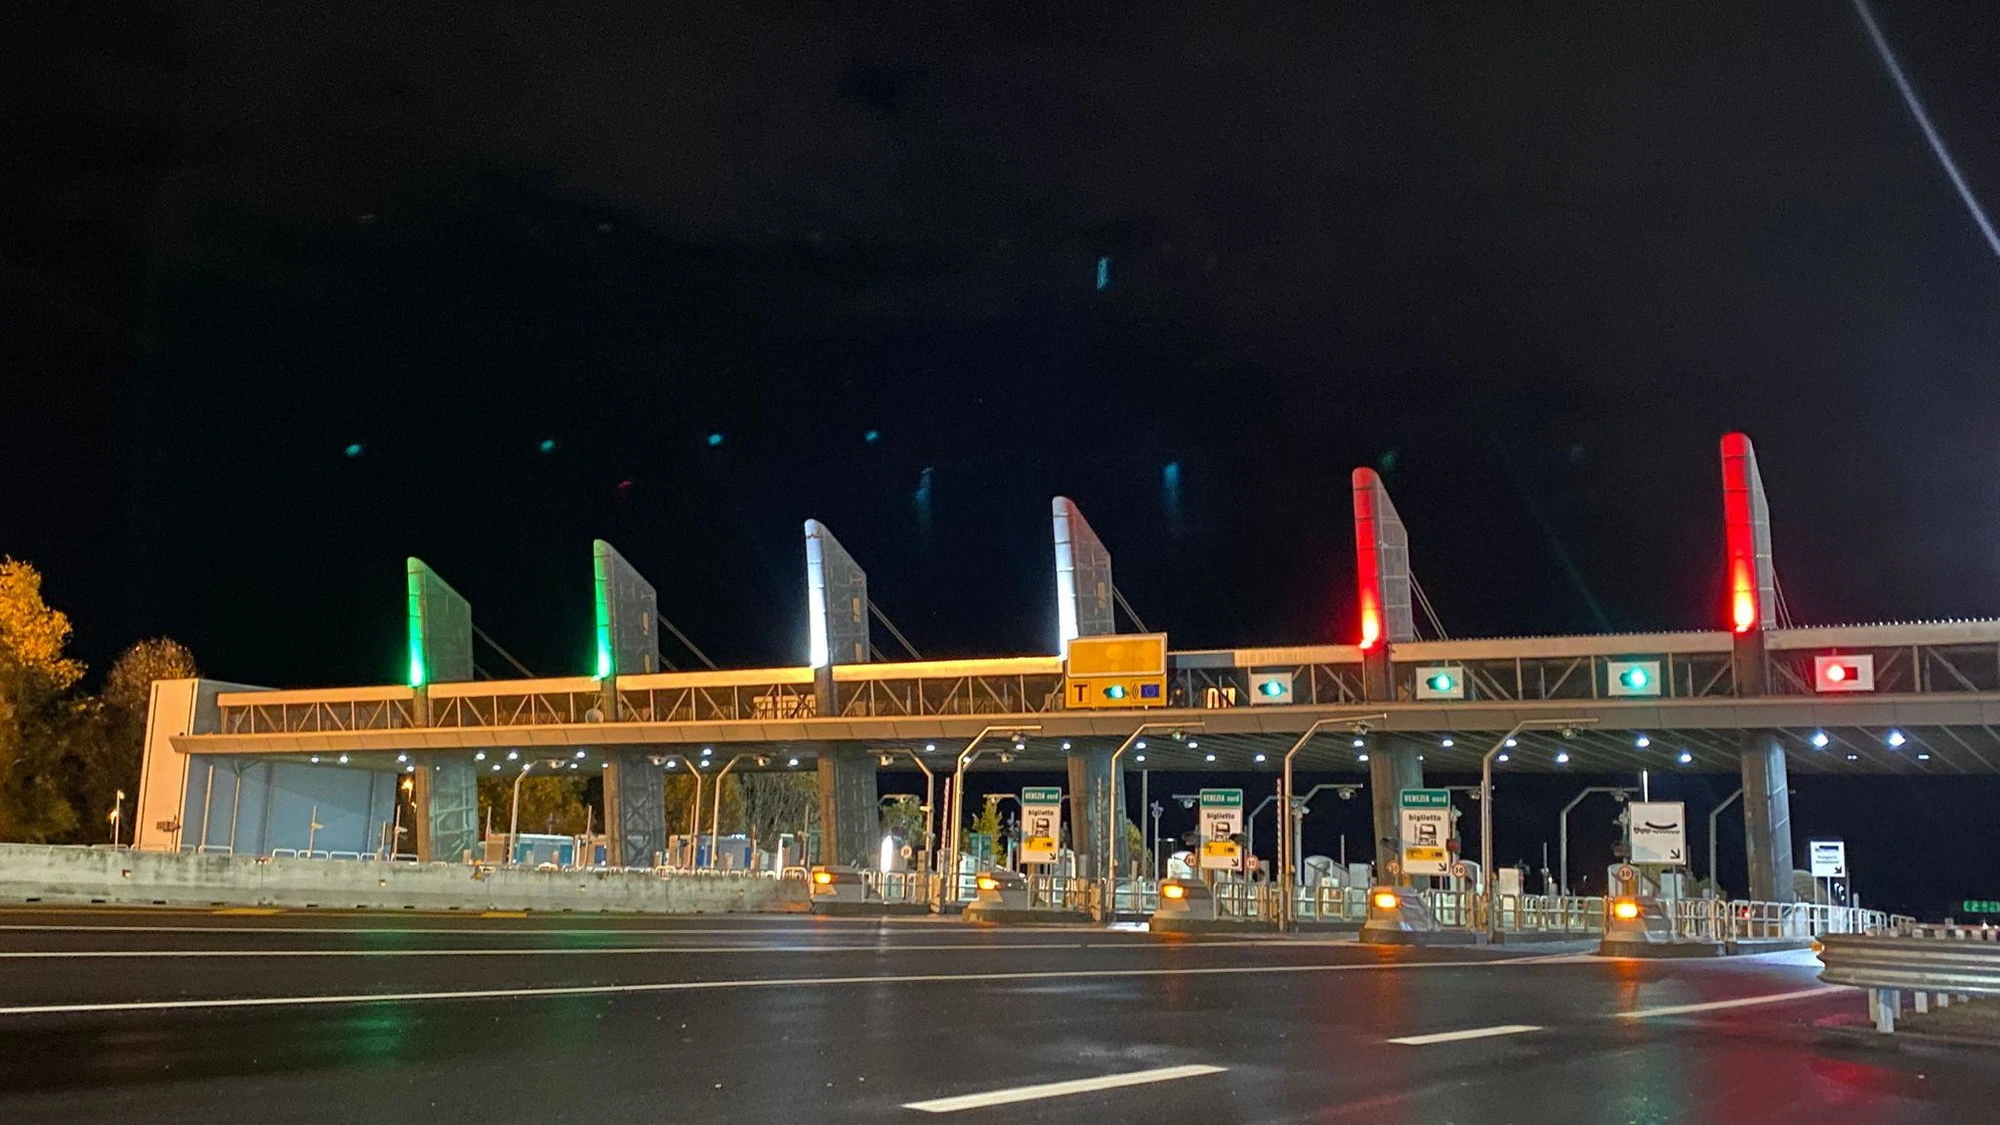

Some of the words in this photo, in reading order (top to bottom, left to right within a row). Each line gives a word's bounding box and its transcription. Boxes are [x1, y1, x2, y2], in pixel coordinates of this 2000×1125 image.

[1074, 684, 1088, 702] T
[1025, 791, 1045, 800] VENEZIA
[1047, 792, 1058, 800] nord
[1203, 794, 1225, 802] VENEZIA
[1432, 795, 1446, 803] nord
[1028, 809, 1054, 817] biglietto
[1207, 812, 1235, 820] biglietto
